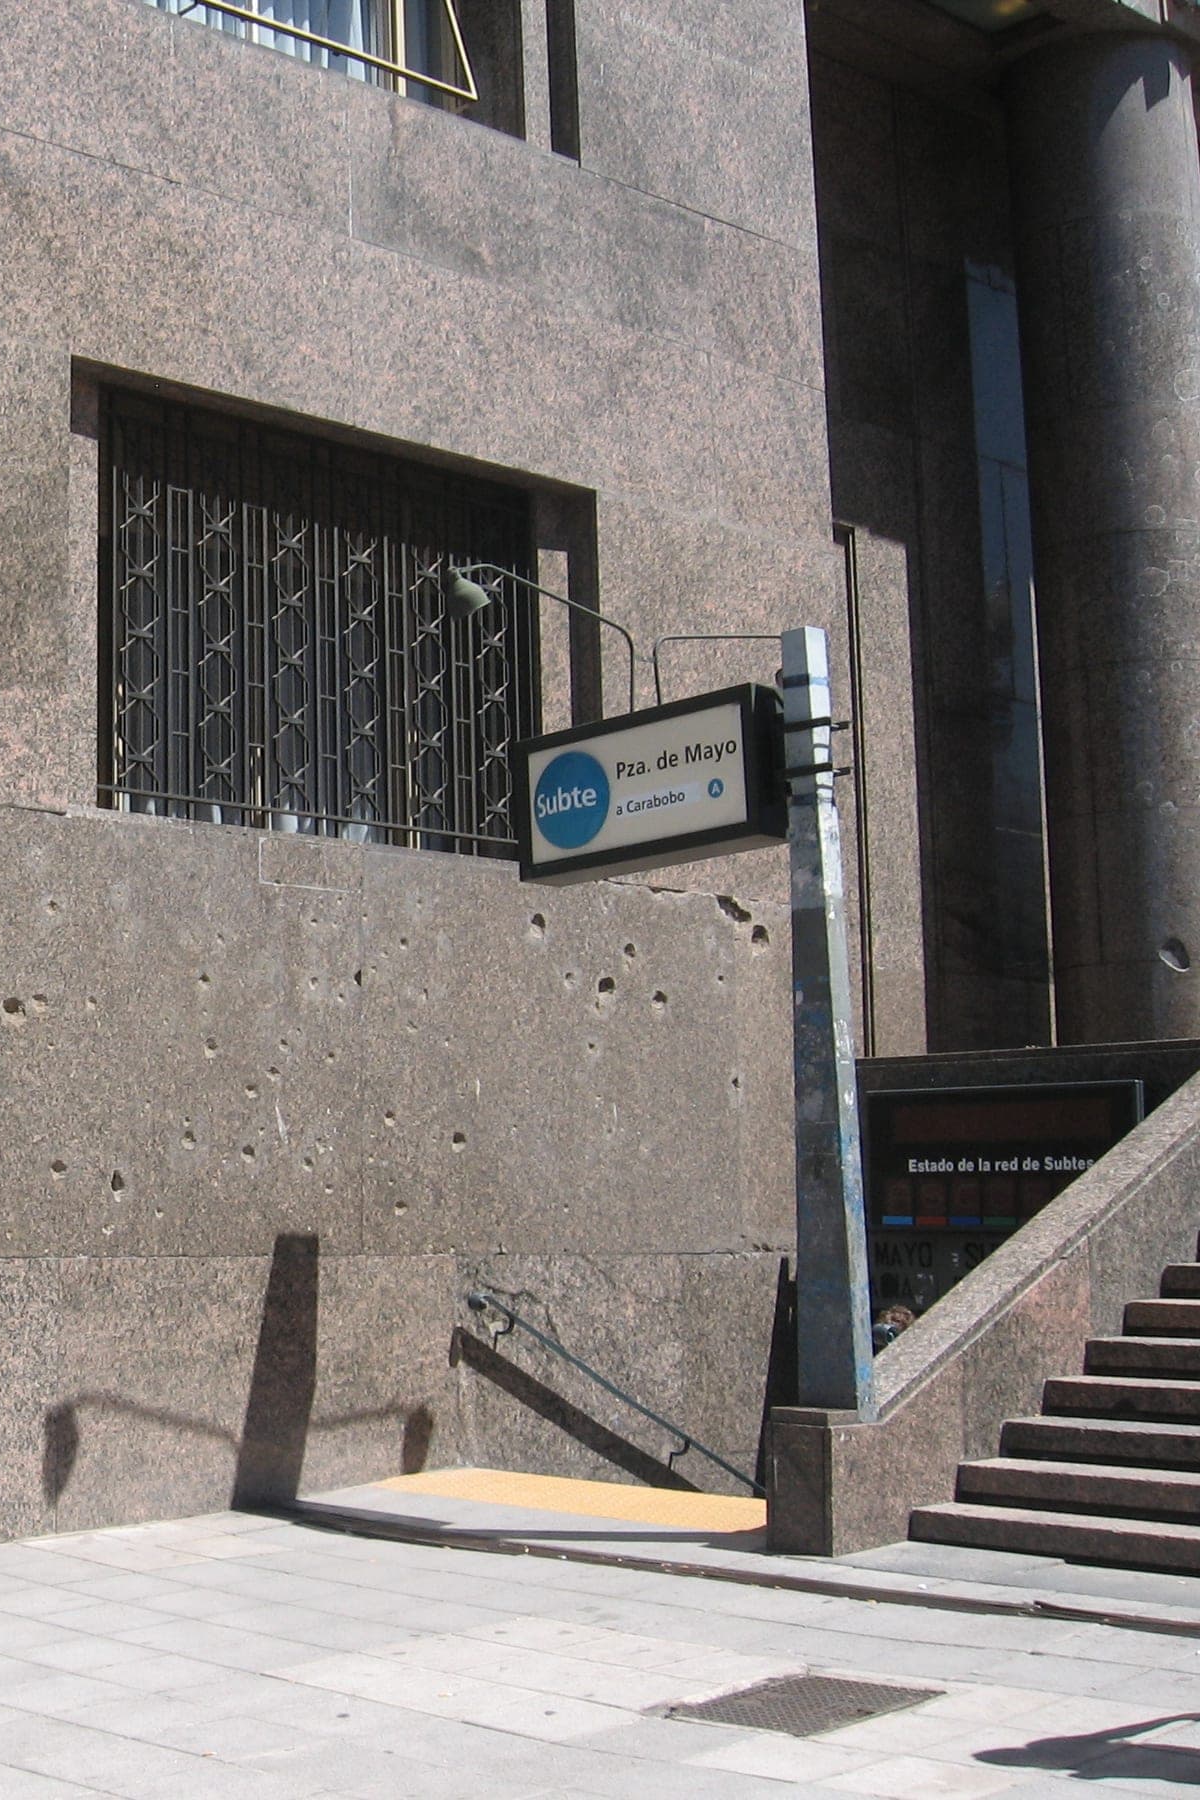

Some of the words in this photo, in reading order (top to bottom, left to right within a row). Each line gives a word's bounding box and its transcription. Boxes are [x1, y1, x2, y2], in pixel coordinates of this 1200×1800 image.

[616, 760, 651, 779] Pza.
[657, 751, 678, 770] de
[685, 738, 737, 765] Mayo
[711, 783, 720, 794] A
[536, 785, 597, 818] Subte
[616, 805, 623, 816] a
[626, 791, 686, 814] Carabobo
[908, 1158, 954, 1173] Estado
[958, 1157, 974, 1172] de
[978, 1157, 990, 1172] la
[995, 1157, 1018, 1171] red
[1022, 1156, 1040, 1171] de
[1044, 1155, 1094, 1171] Subtes
[875, 1242, 933, 1268] MAYO
